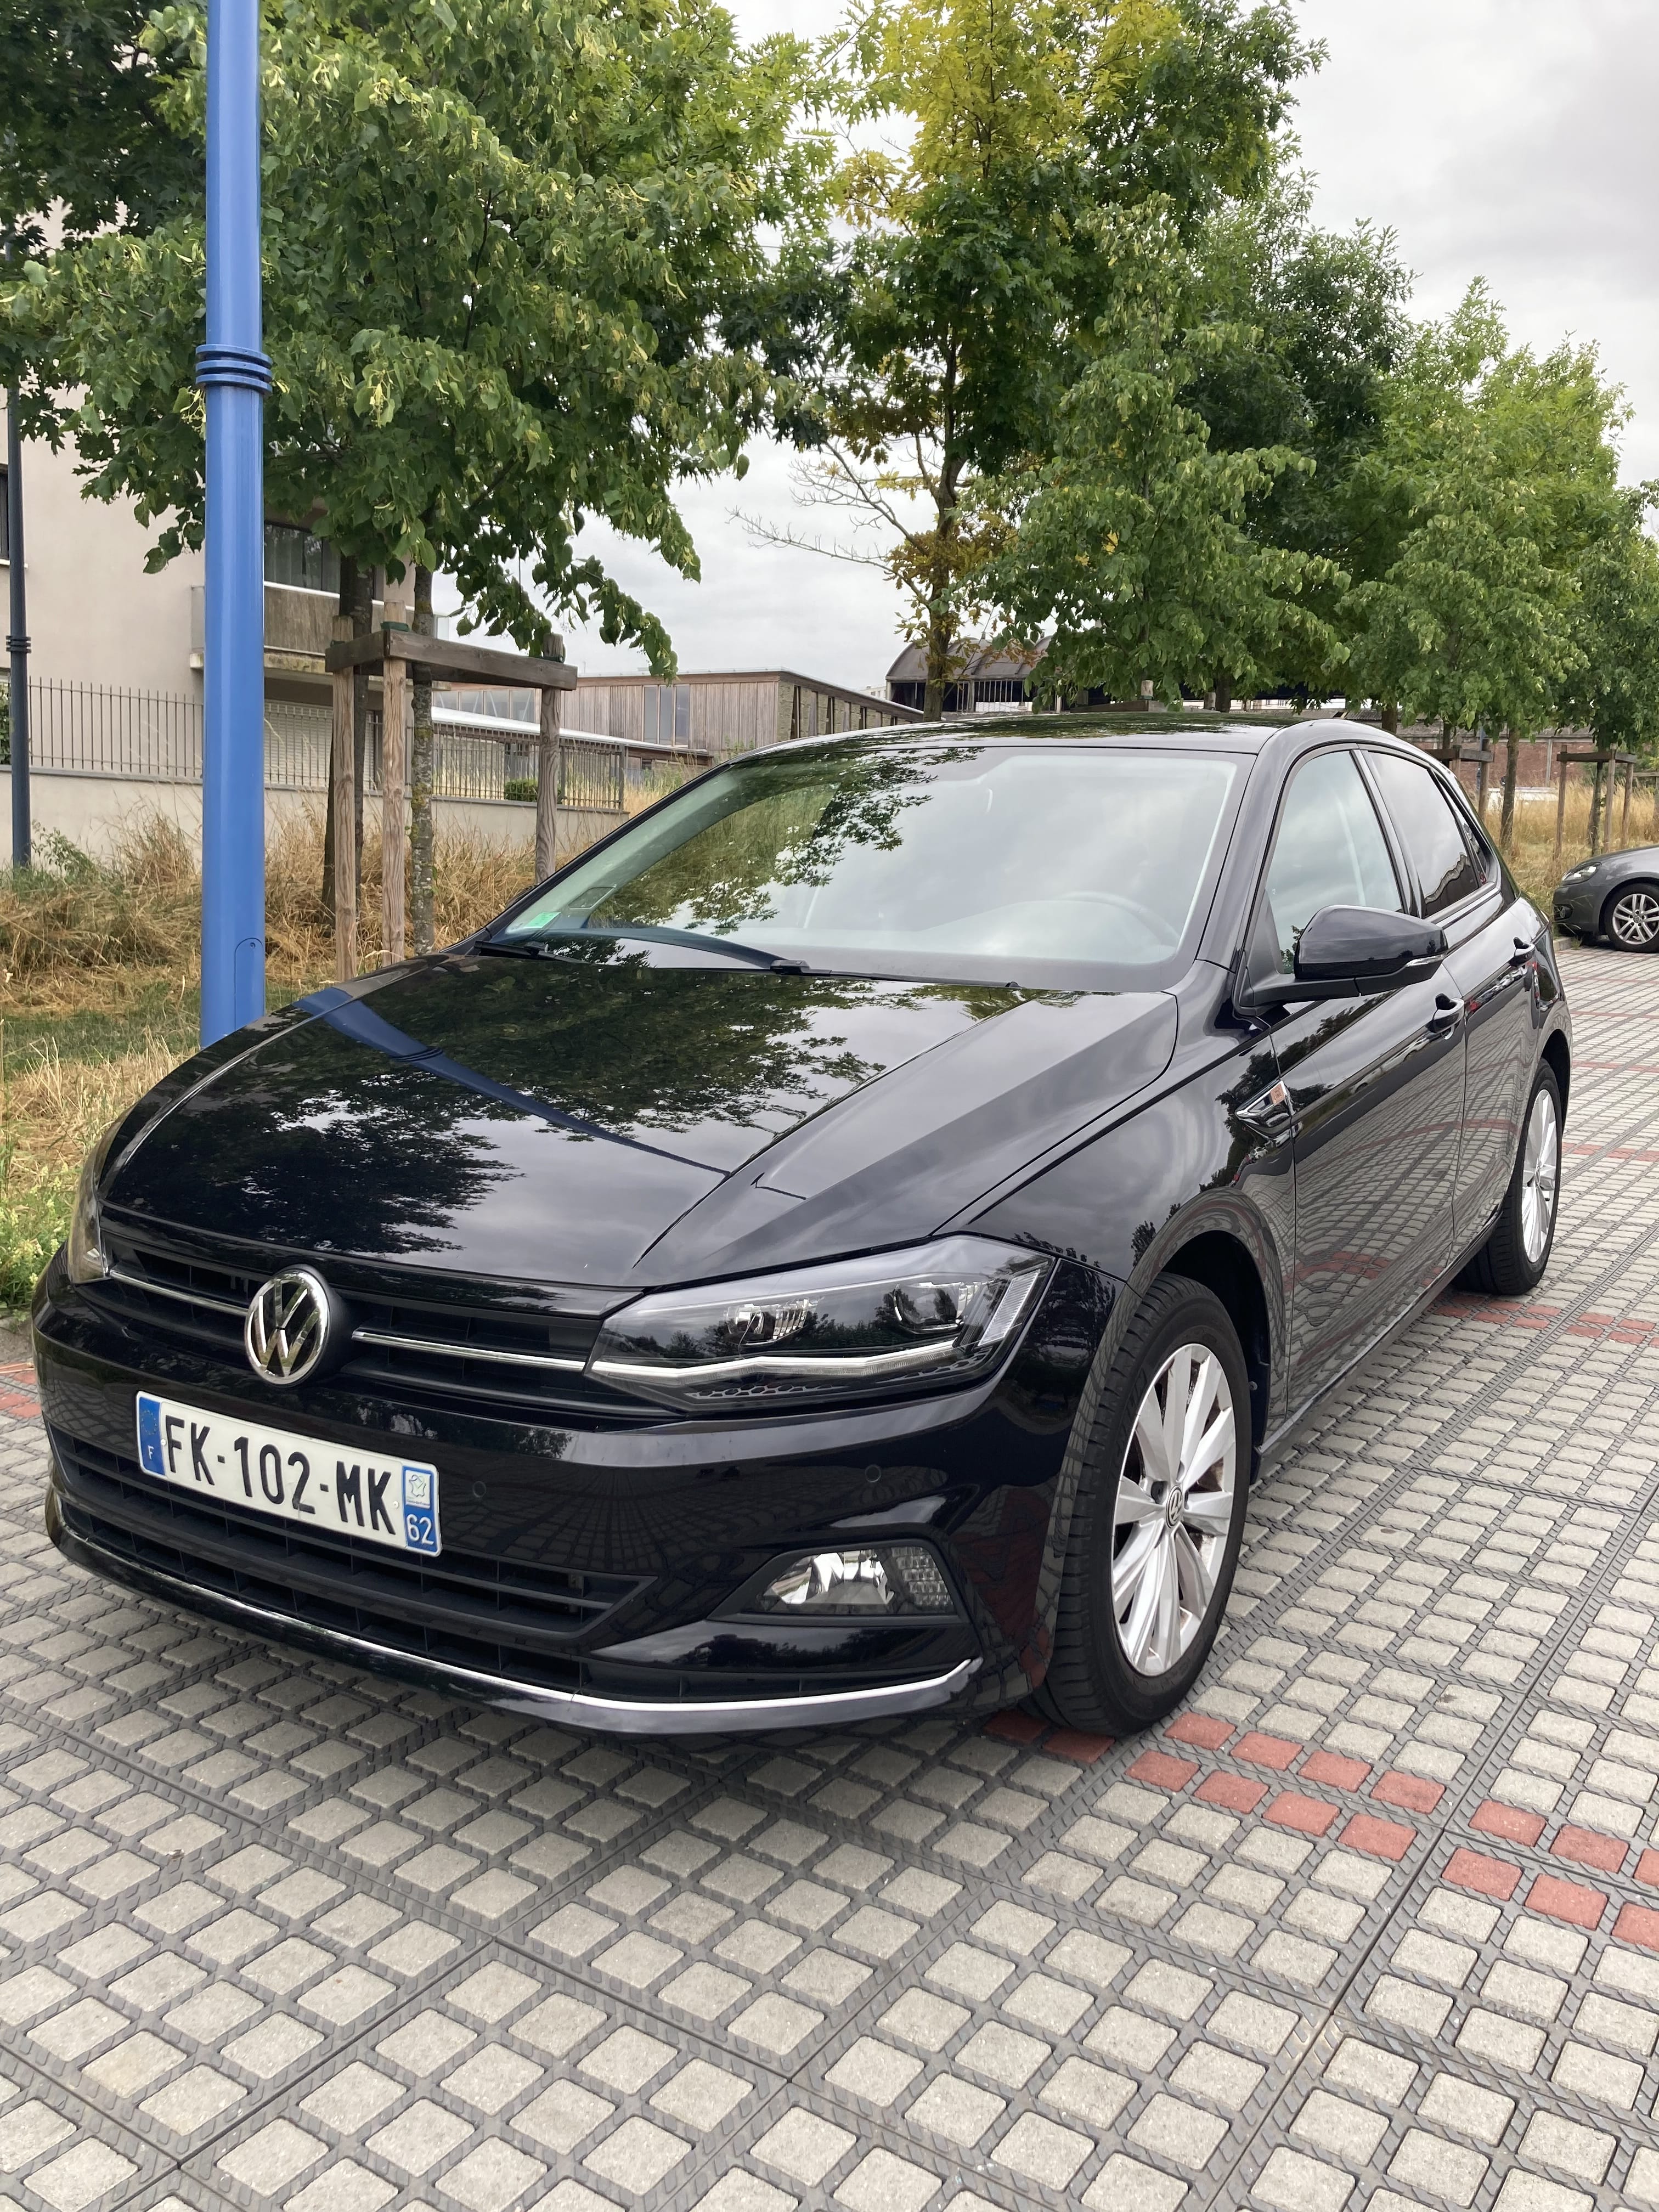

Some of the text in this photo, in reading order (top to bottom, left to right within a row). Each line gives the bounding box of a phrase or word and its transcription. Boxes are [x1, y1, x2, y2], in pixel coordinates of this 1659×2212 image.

[147, 1446, 155, 1460] F
[165, 1415, 396, 1535] FK-102-MK
[407, 1514, 434, 1545] 62
